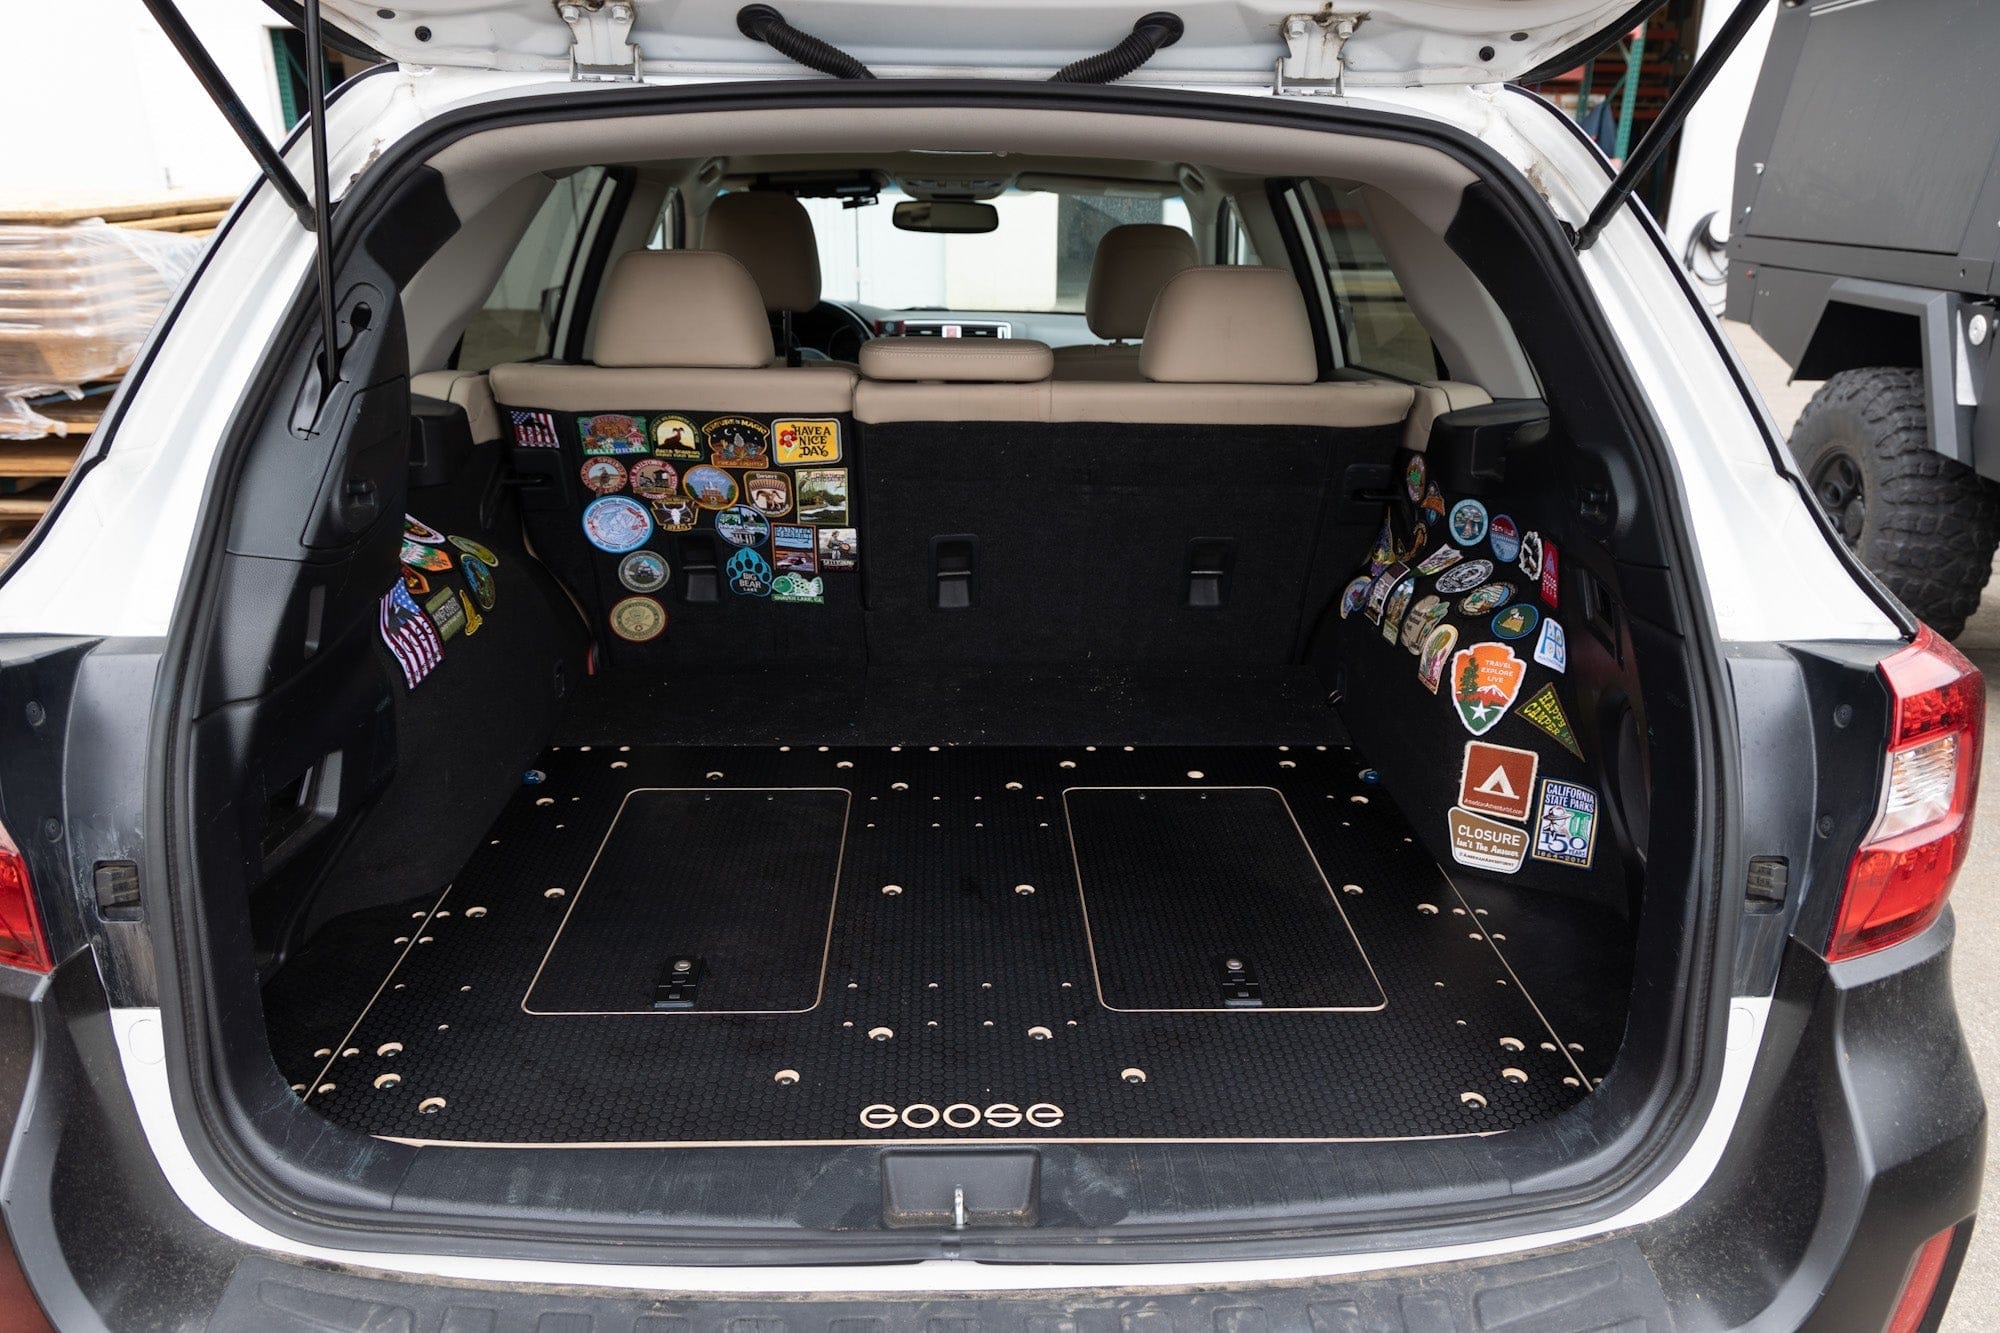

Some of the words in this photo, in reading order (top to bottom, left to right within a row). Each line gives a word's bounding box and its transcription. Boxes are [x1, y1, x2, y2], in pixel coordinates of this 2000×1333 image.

[741, 420, 767, 434] MAGIC
[791, 424, 822, 436] HAVE
[823, 426, 831, 436] A
[799, 435, 828, 446] NICE
[587, 447, 647, 455] CALIFORNIA
[799, 446, 829, 458] DAY
[739, 579, 762, 588] BEAR
[1486, 660, 1512, 669] TRAVEL
[1481, 667, 1513, 677] EXPLORE
[1539, 691, 1566, 727] HAPPY
[1524, 702, 1560, 735] CAMPER
[1547, 783, 1594, 804] CALIFORNIA
[1545, 793, 1569, 807] STATE
[1570, 799, 1594, 813] PARKS
[1458, 824, 1521, 846] CLOSURE
[1540, 831, 1588, 853] 150
[1456, 838, 1473, 849] Isn't
[1476, 841, 1488, 852] The
[859, 1103, 1064, 1129] GOOSE
